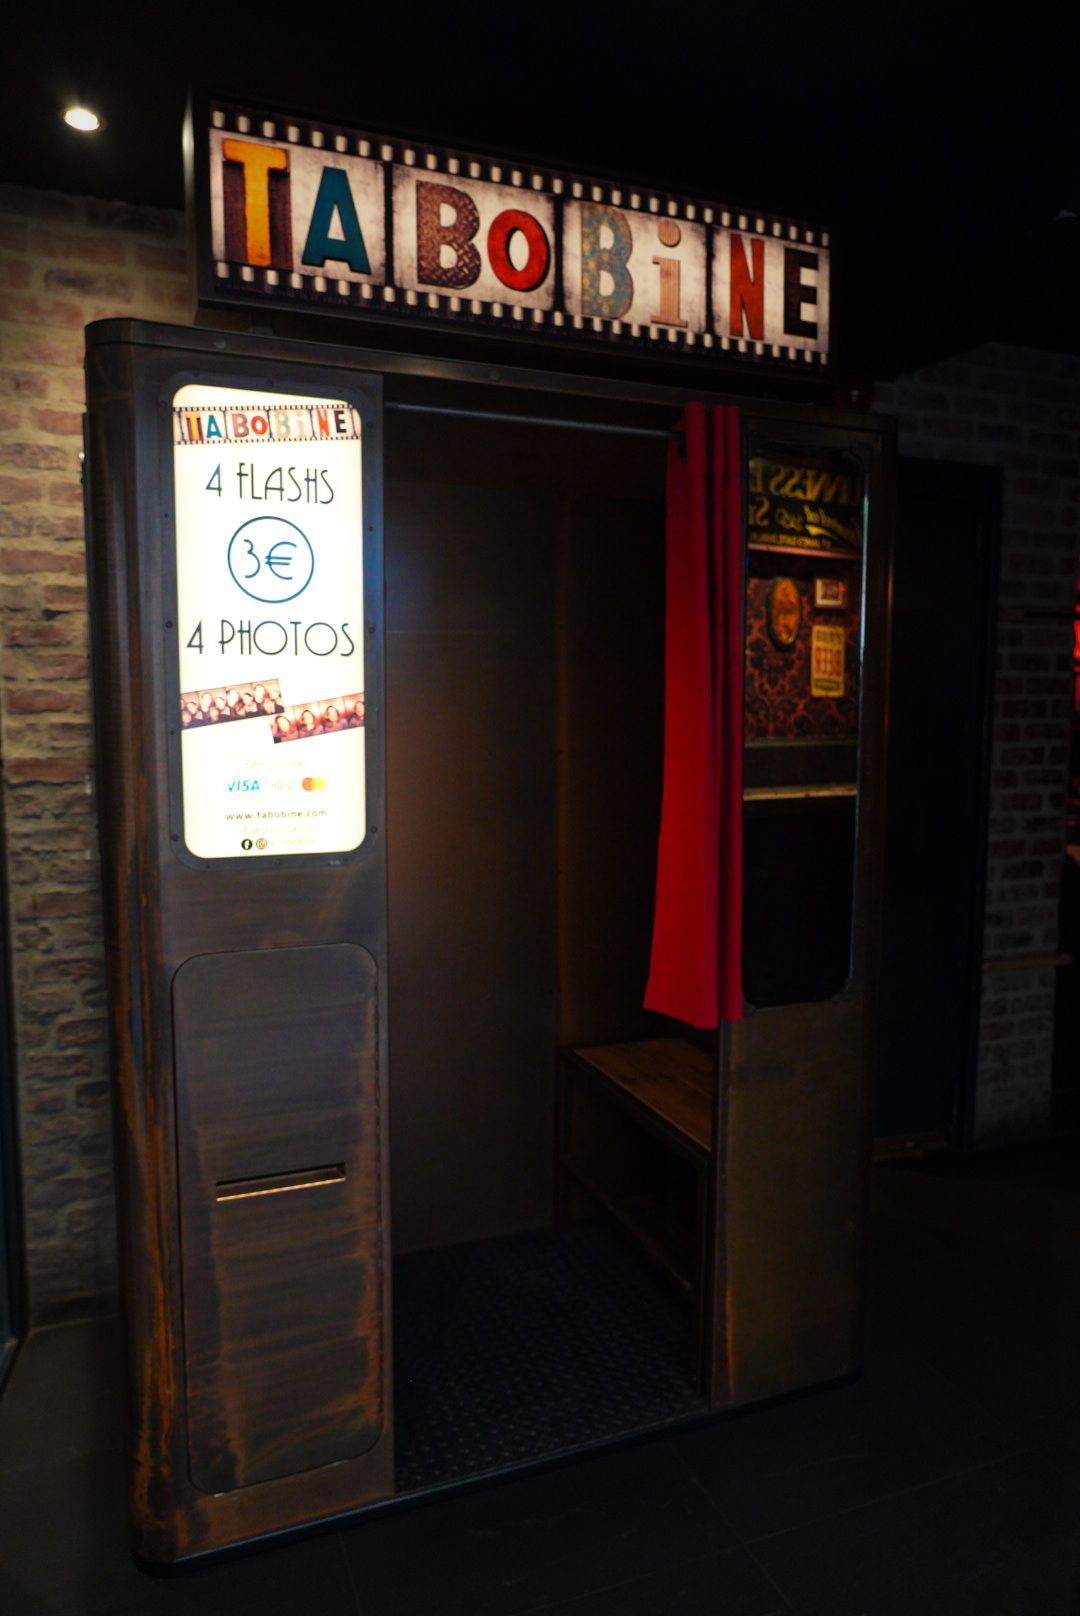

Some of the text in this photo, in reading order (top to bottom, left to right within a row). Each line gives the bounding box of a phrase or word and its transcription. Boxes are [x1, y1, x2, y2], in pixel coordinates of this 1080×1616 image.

[205, 462, 335, 505] 4 FLASHS
[243, 538, 298, 581] 3€
[186, 618, 355, 658] 4 PHOTOS
[227, 780, 261, 793] VISA
[226, 808, 328, 821] www.tabobine.com
